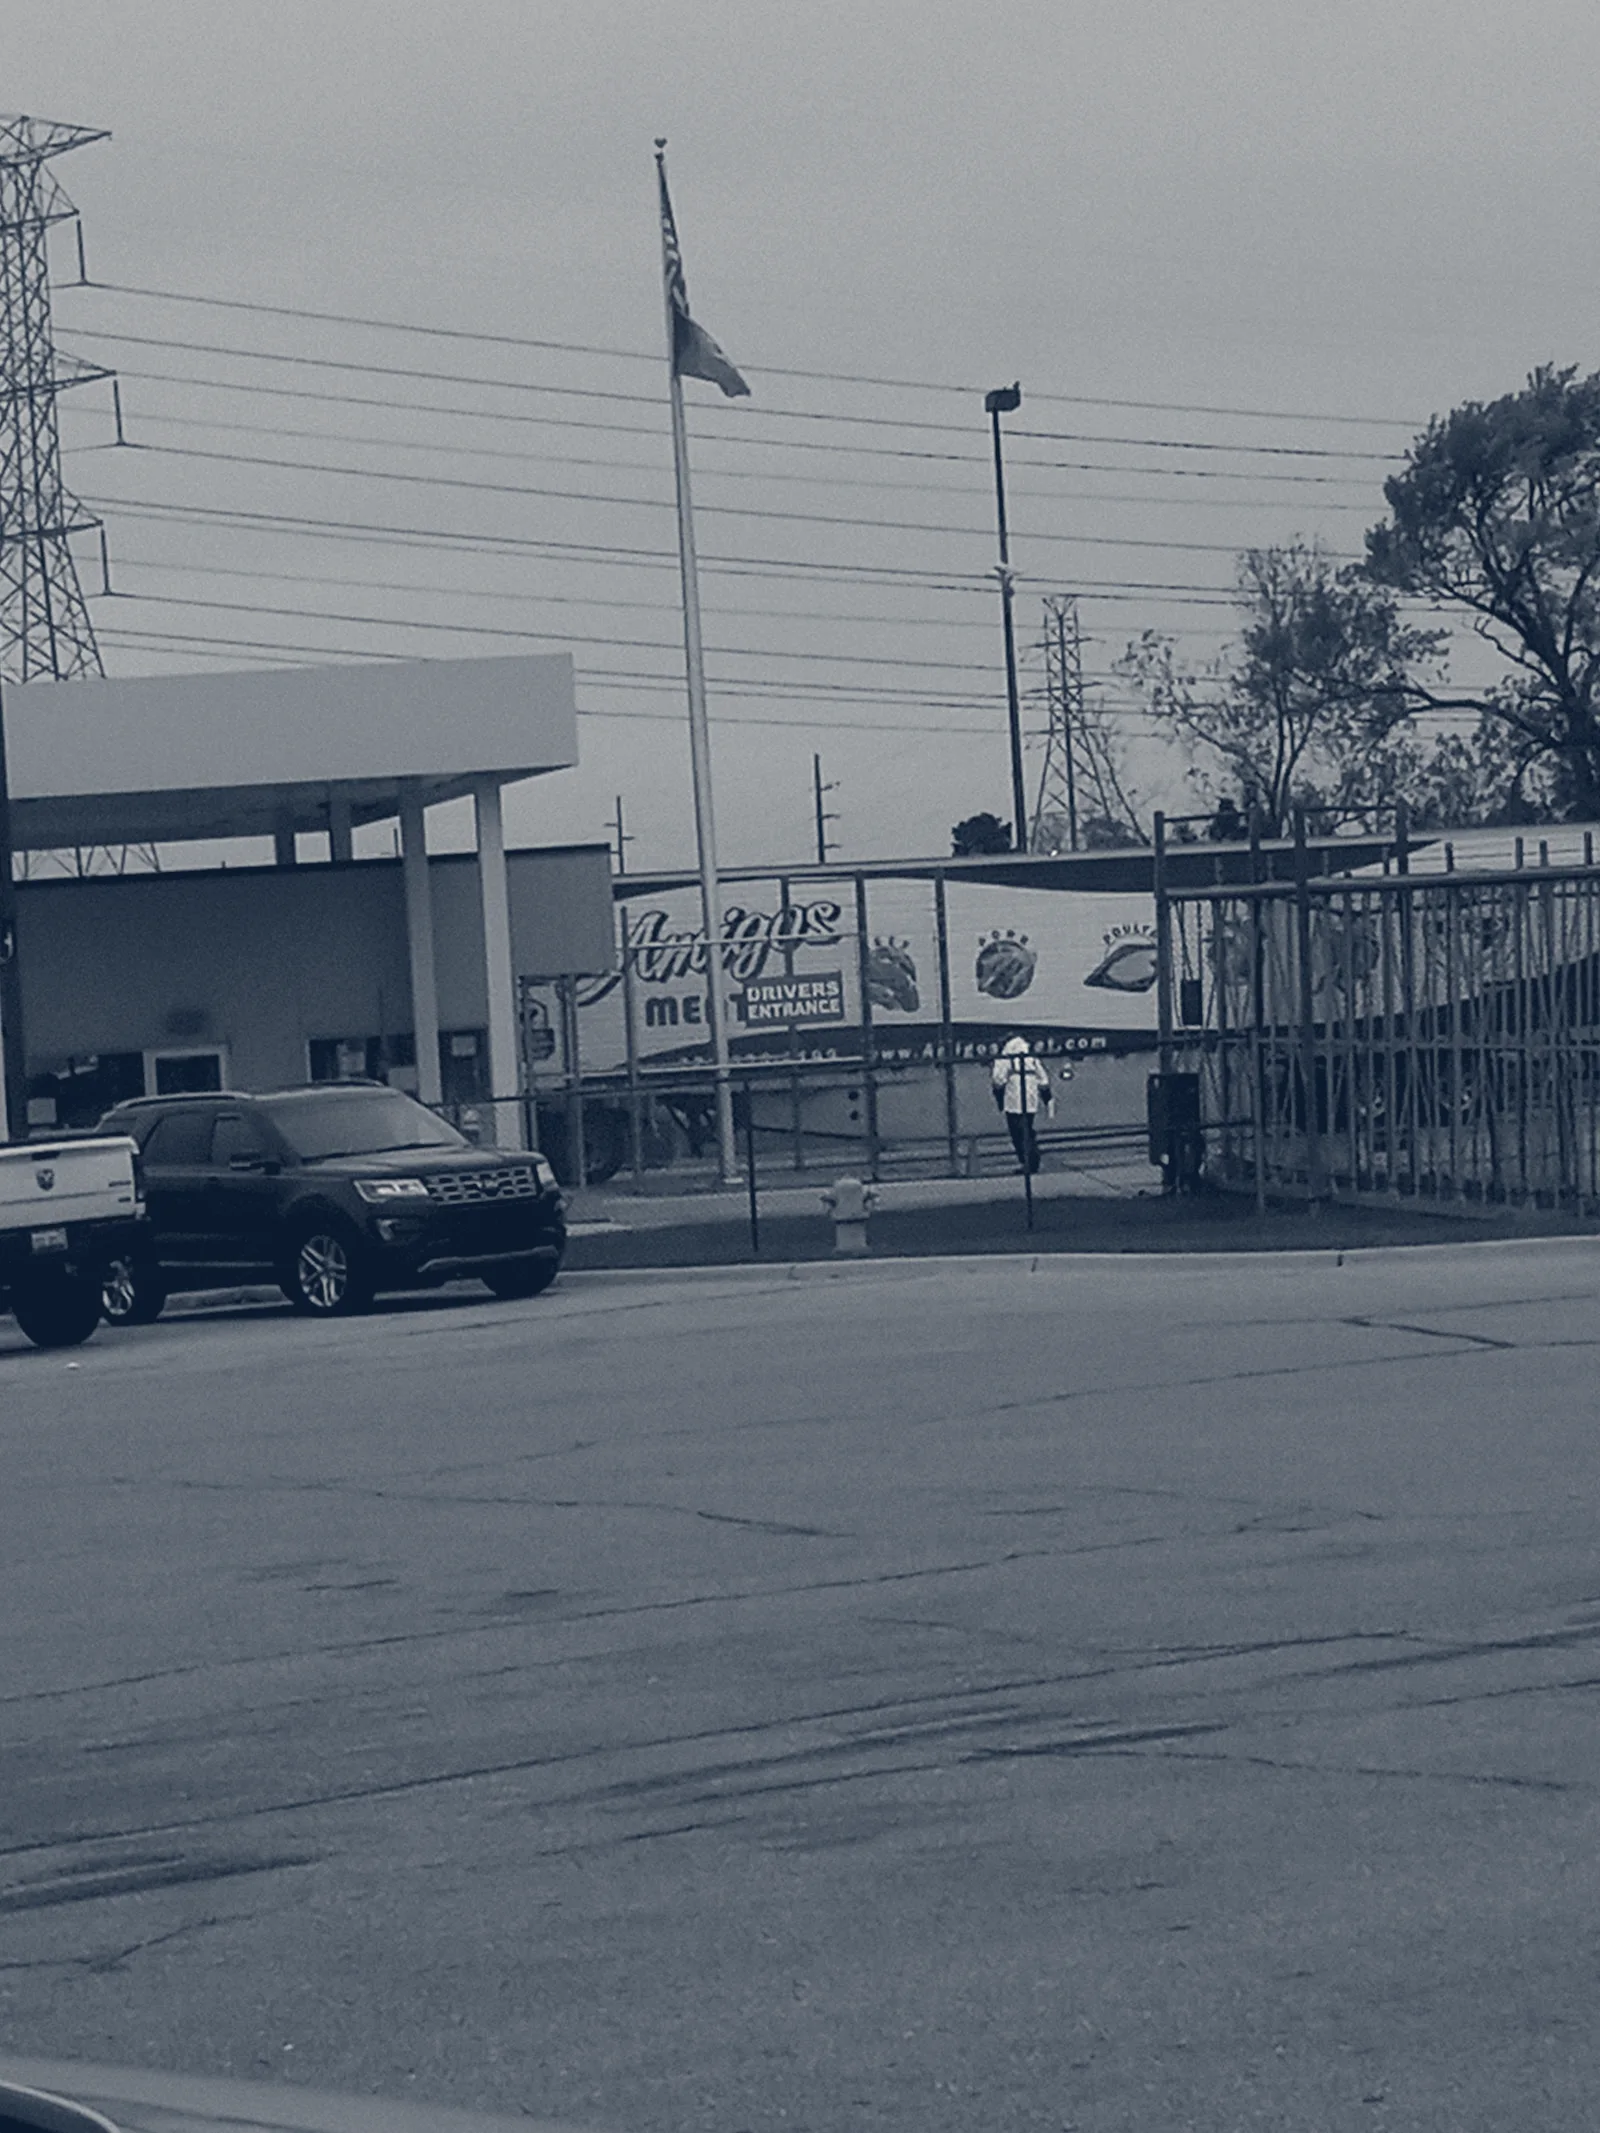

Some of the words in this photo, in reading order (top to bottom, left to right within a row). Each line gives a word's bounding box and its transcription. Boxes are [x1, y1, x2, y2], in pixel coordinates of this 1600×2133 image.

[627, 901, 842, 984] Amigos
[1102, 923, 1158, 946] POULT
[747, 981, 840, 1002] DRIVERS
[748, 998, 841, 1020] ENTRANCE
